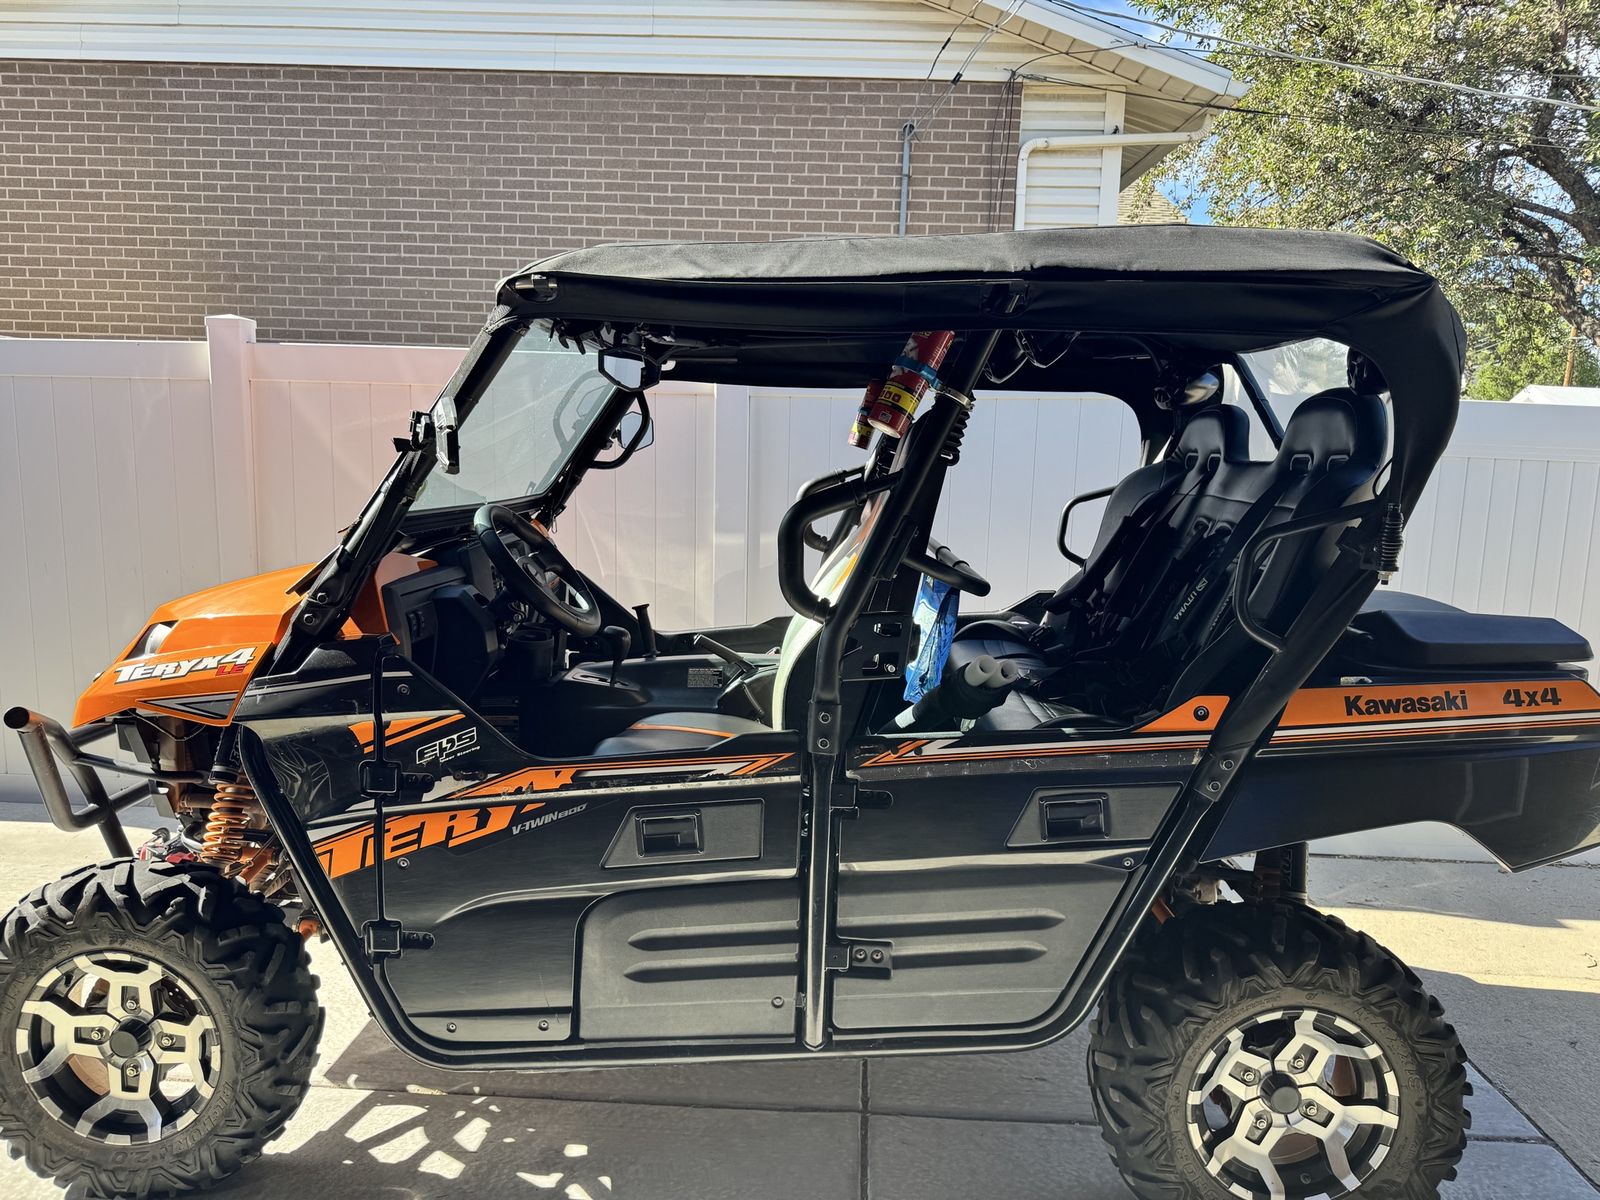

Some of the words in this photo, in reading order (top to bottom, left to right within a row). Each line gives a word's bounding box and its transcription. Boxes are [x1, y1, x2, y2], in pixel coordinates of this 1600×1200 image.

[114, 646, 257, 684] TERYX4
[216, 663, 250, 677] LE
[1344, 690, 1468, 716] Kawasaki
[1503, 687, 1562, 707] 4x4
[416, 727, 477, 764] EPS
